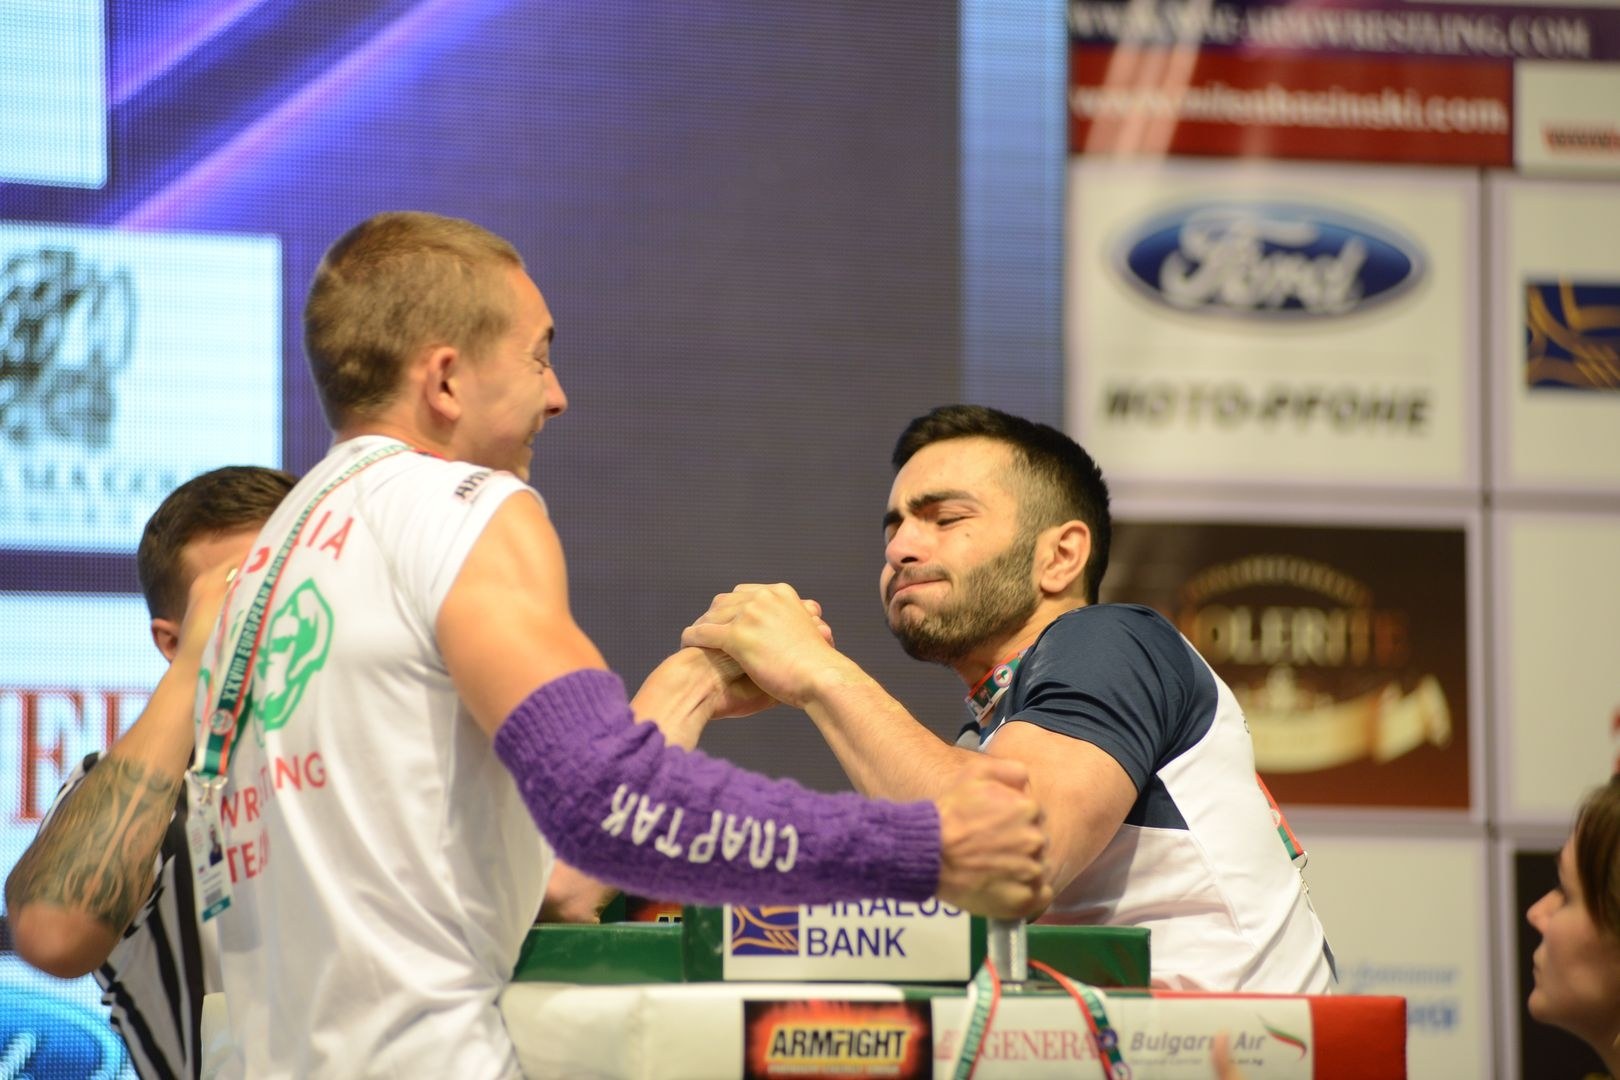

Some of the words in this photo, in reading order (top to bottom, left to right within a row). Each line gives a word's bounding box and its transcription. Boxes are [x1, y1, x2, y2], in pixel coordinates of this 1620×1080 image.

[1159, 205, 1367, 314] Ford
[237, 585, 270, 655] EUROPEAN
[807, 927, 906, 957] BANK
[771, 1029, 906, 1059] ARMFIGHT
